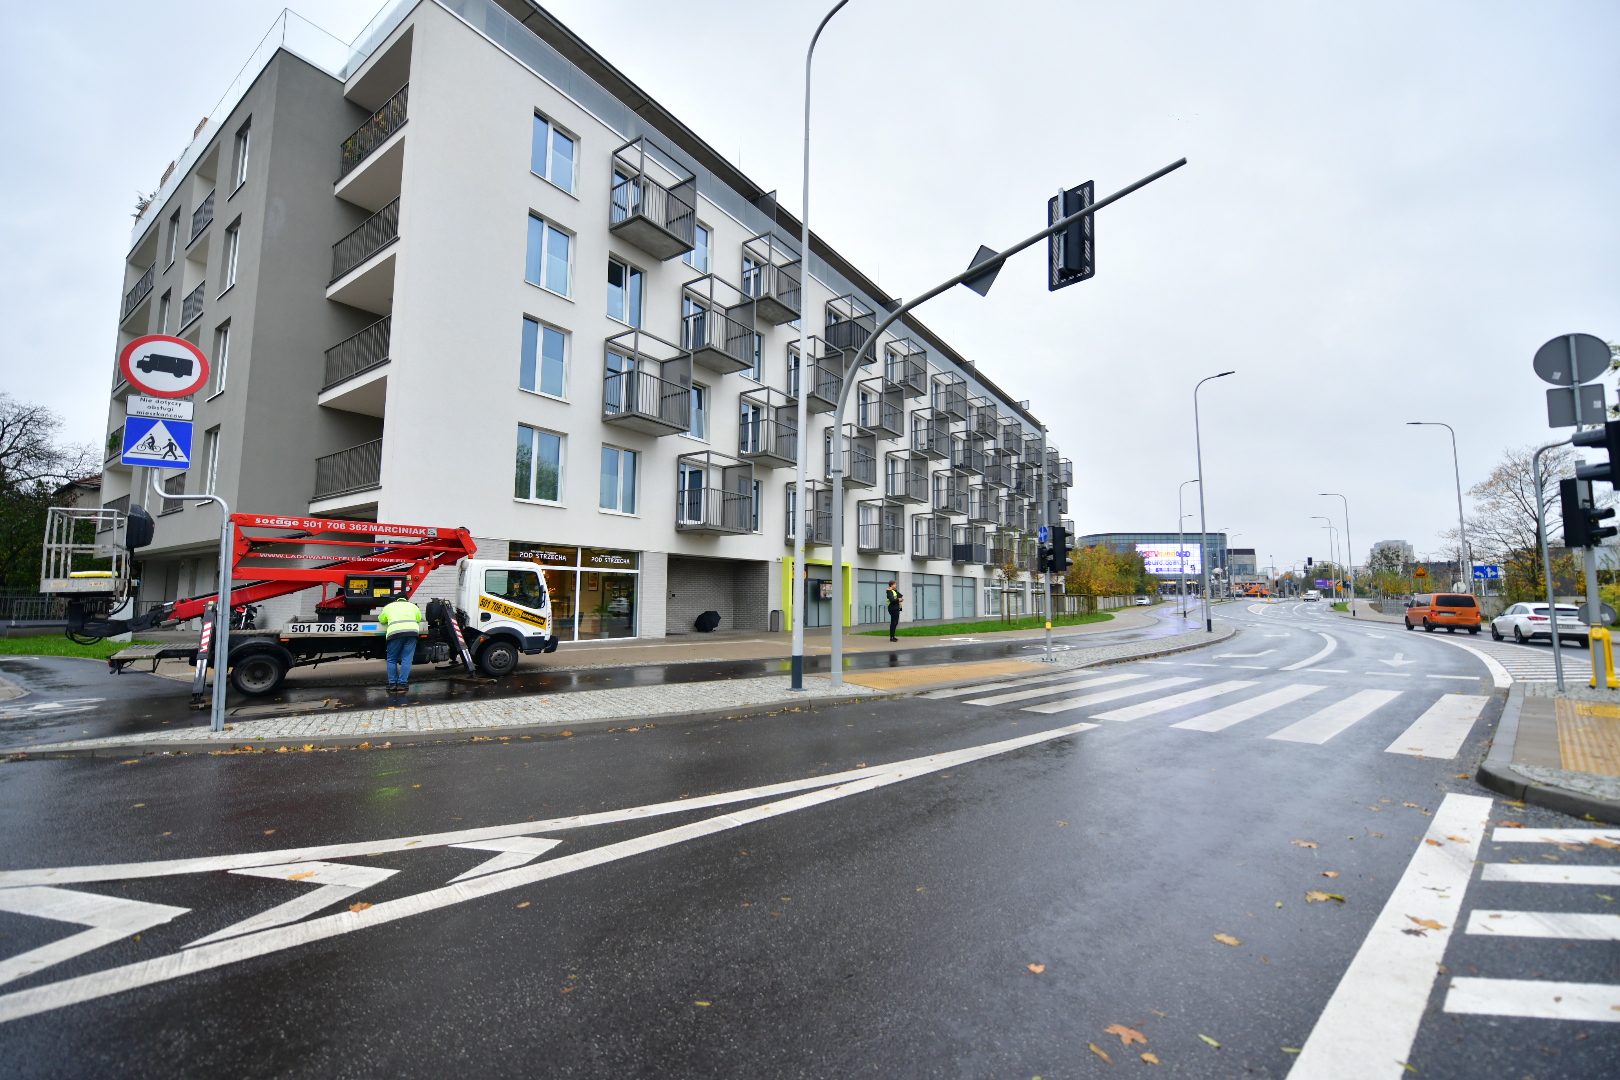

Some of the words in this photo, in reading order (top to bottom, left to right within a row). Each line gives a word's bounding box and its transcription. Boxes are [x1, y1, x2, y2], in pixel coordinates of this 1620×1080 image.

[155, 398, 182, 407] dotyczy
[136, 410, 184, 419] mieszkańców
[255, 518, 300, 527] socage
[302, 520, 322, 528] 501
[326, 522, 346, 530] 706
[349, 524, 368, 532] 362
[368, 525, 426, 535] MARCINIAK
[480, 598, 491, 608] 501
[491, 602, 502, 612] 706
[502, 606, 513, 616] 362
[292, 624, 311, 633] 501
[316, 624, 336, 632] 706
[340, 624, 359, 632] 362
